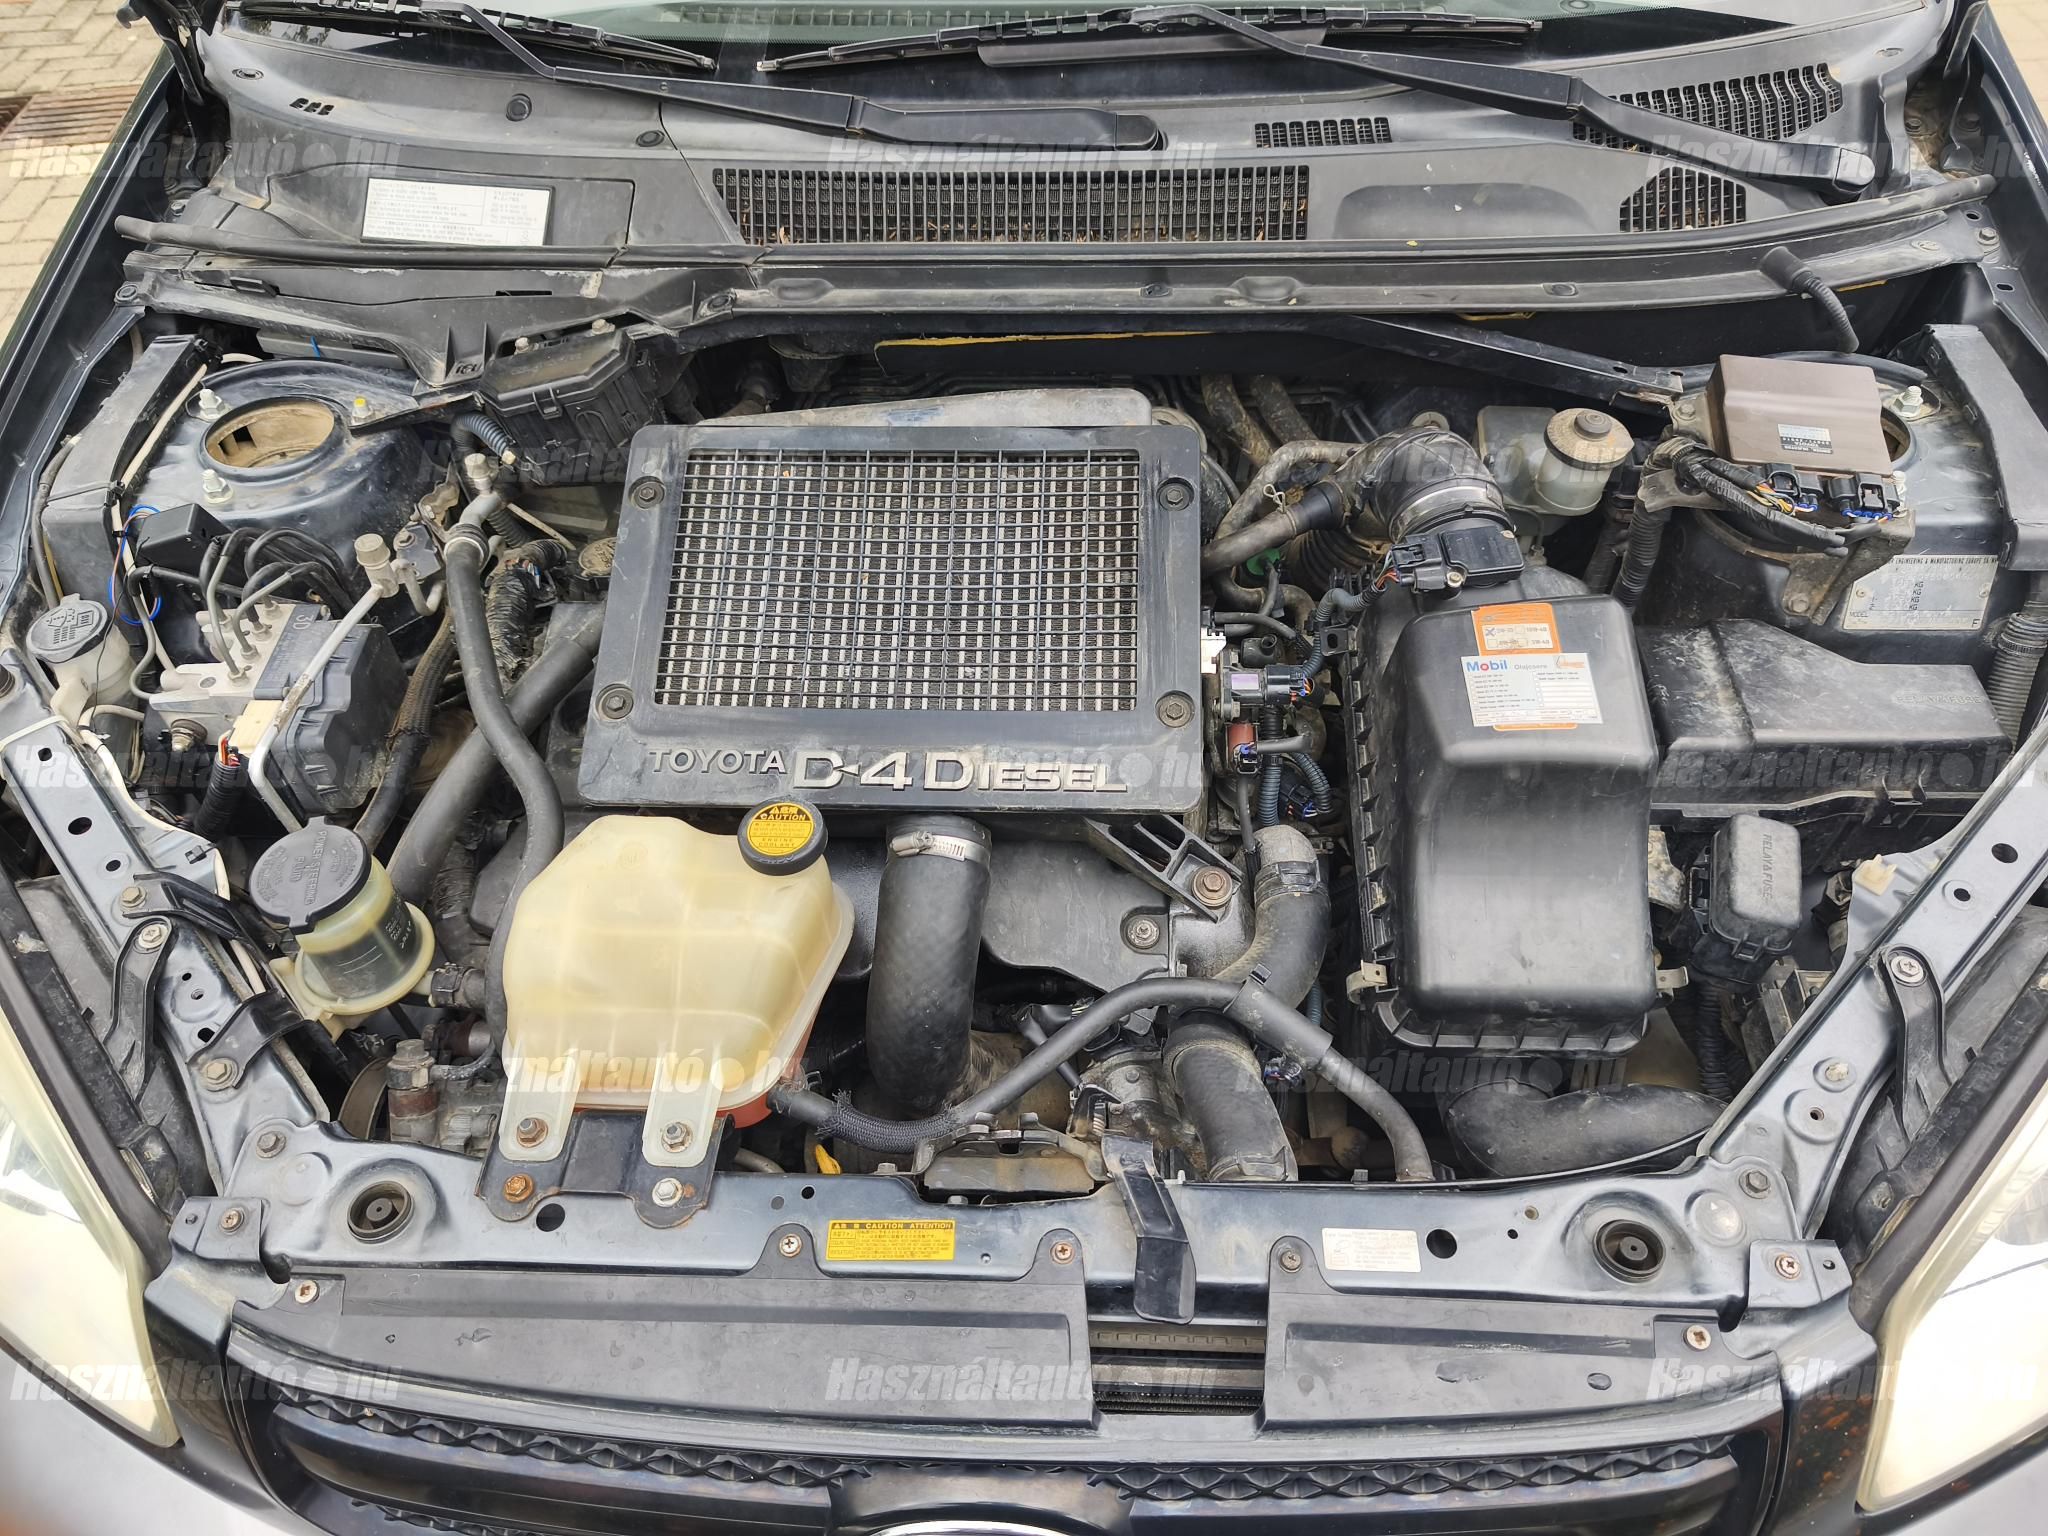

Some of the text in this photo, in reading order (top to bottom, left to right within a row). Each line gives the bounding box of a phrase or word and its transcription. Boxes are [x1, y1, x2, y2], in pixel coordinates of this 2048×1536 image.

[1466, 659, 1508, 672] Mobil
[648, 749, 788, 775] TOYOTA
[760, 813, 806, 821] CAUTION
[289, 855, 305, 883] FLUID
[304, 831, 327, 906] POWER STEERING
